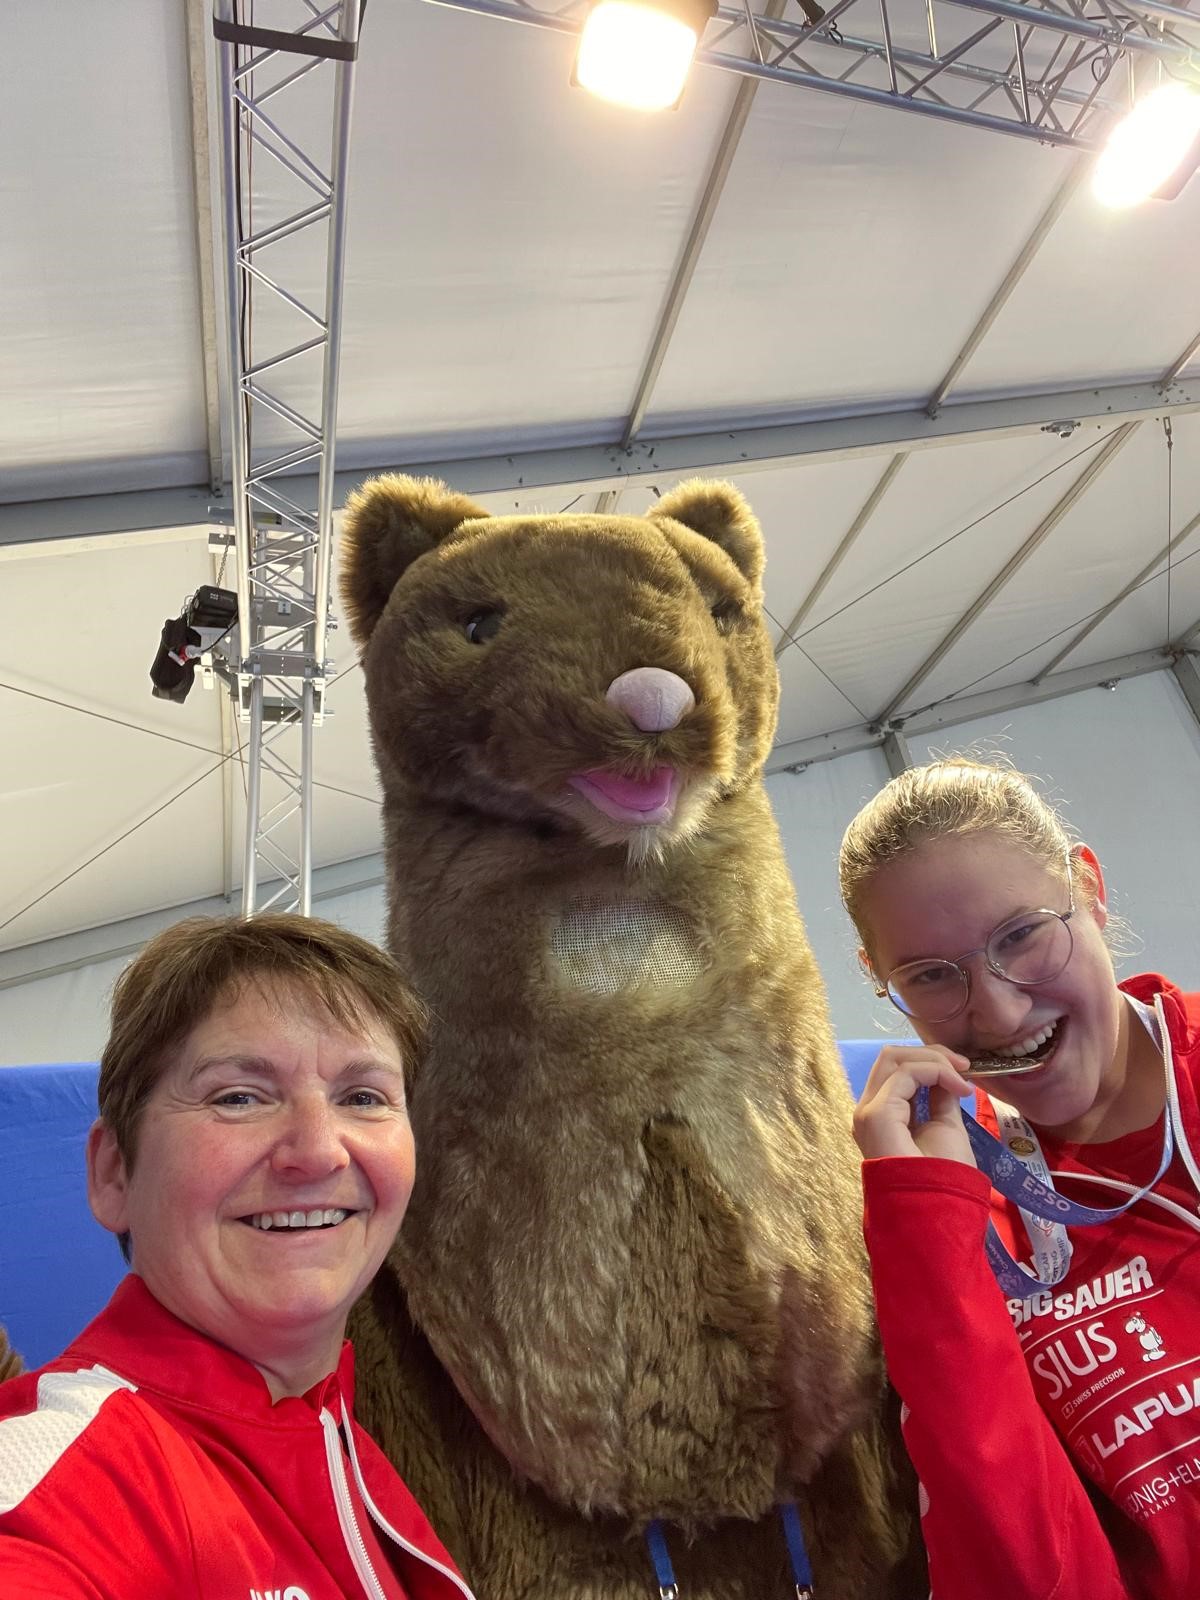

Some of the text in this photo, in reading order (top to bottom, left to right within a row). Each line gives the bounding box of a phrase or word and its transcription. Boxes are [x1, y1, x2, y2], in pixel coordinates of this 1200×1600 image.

[1022, 1175, 1071, 1212] EPSO
[1054, 1255, 1154, 1321] SAUER
[1033, 1321, 1118, 1400] SIUS
[1072, 1367, 1126, 1409] SWISS PRECISION
[1091, 1377, 1200, 1459] LAPU
